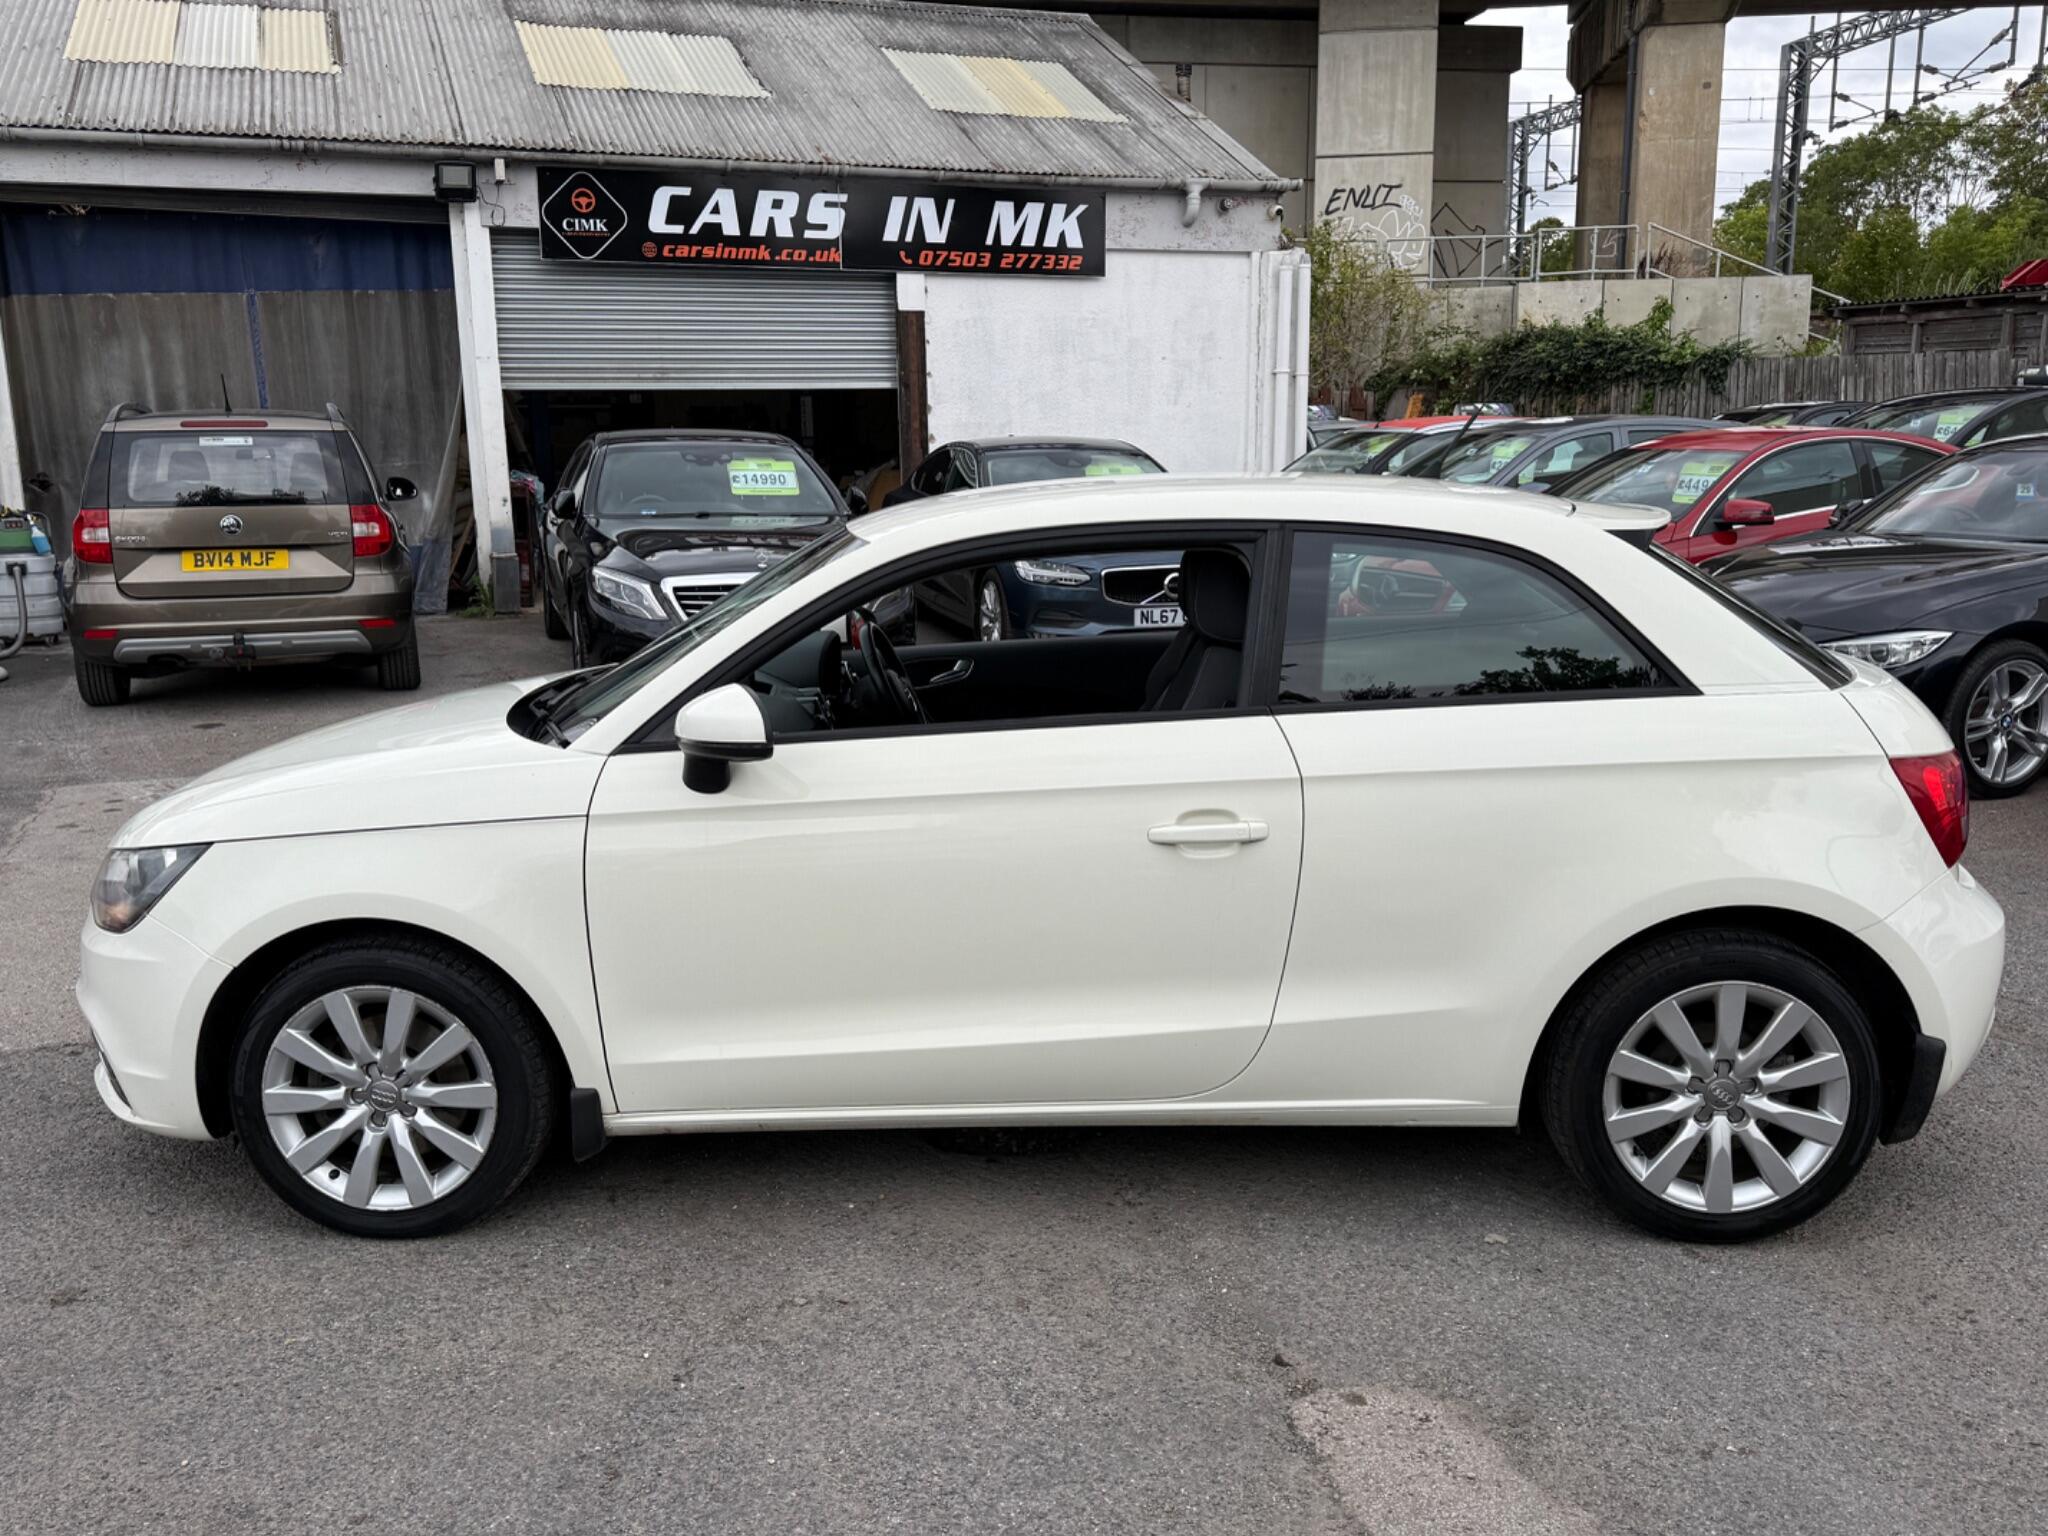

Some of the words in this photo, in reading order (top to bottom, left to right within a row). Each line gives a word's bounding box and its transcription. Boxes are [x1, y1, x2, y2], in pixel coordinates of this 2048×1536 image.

[562, 217, 608, 232] CIMK
[648, 186, 848, 239] CARS
[882, 196, 955, 243] IN
[985, 200, 1089, 248] MK
[918, 250, 991, 267] 07503
[1000, 253, 1083, 270] 277332
[732, 473, 787, 485] £14990
[193, 552, 235, 568] BV14
[240, 551, 276, 567] MJF
[1140, 609, 1179, 624] NL67
